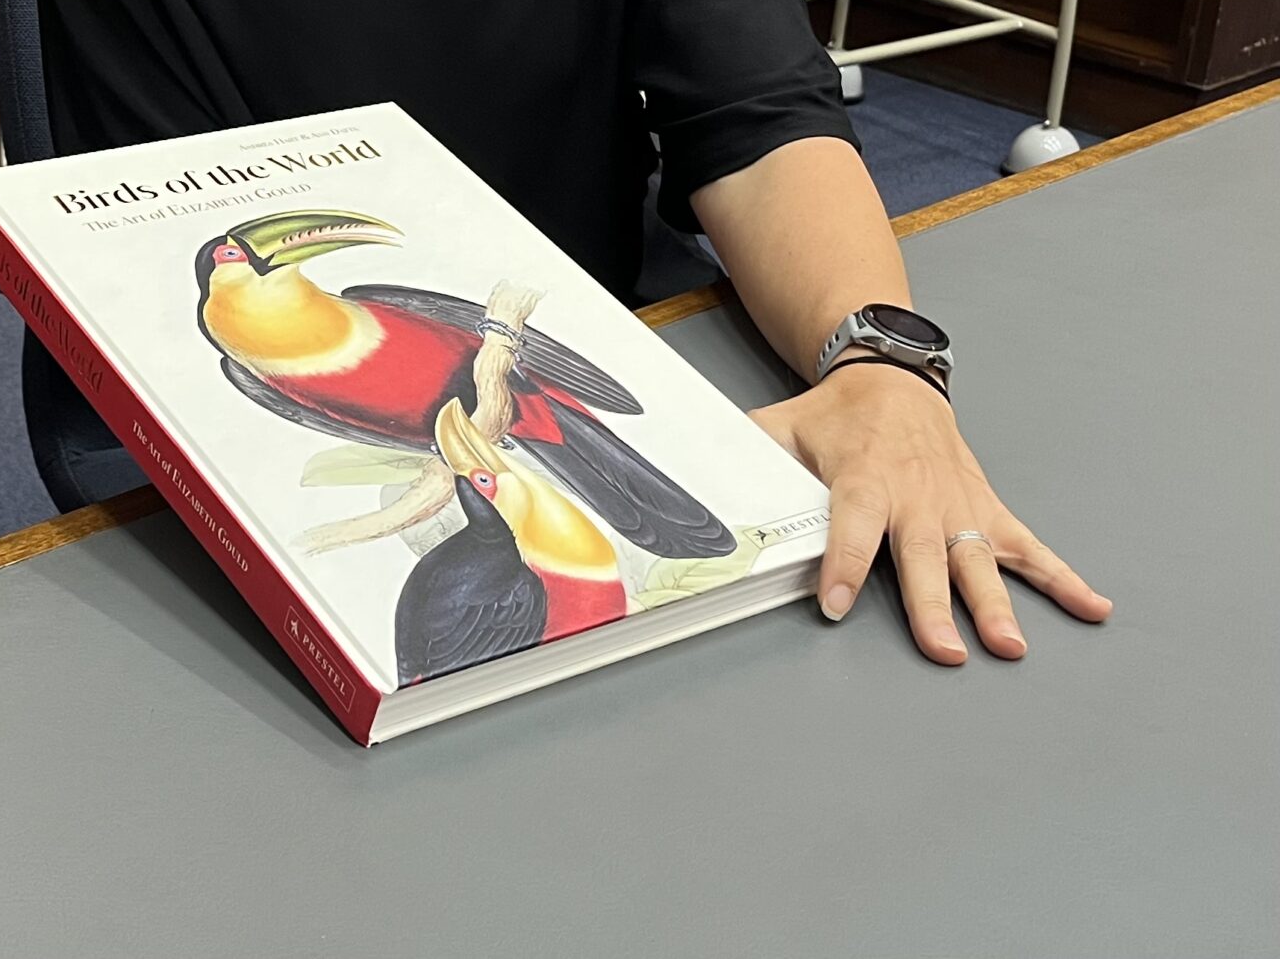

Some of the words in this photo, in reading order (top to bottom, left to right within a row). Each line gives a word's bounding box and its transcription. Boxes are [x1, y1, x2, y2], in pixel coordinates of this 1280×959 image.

[53, 181, 158, 214] Birds
[165, 170, 203, 194] of
[206, 165, 270, 186] the
[266, 140, 382, 174] World
[82, 218, 119, 232] The
[122, 213, 147, 226] Art
[149, 208, 166, 222] of
[169, 194, 255, 217] ELIZABETH
[255, 183, 311, 201] GOULD
[30, 295, 56, 331] the
[58, 322, 104, 394] World
[131, 419, 148, 447] The
[147, 442, 163, 463] Art
[161, 461, 172, 476] of
[172, 470, 217, 534] ELIZABETH
[217, 527, 249, 573] GOULD
[772, 514, 831, 536] PRESTEL
[303, 635, 345, 696] PRESTEL
